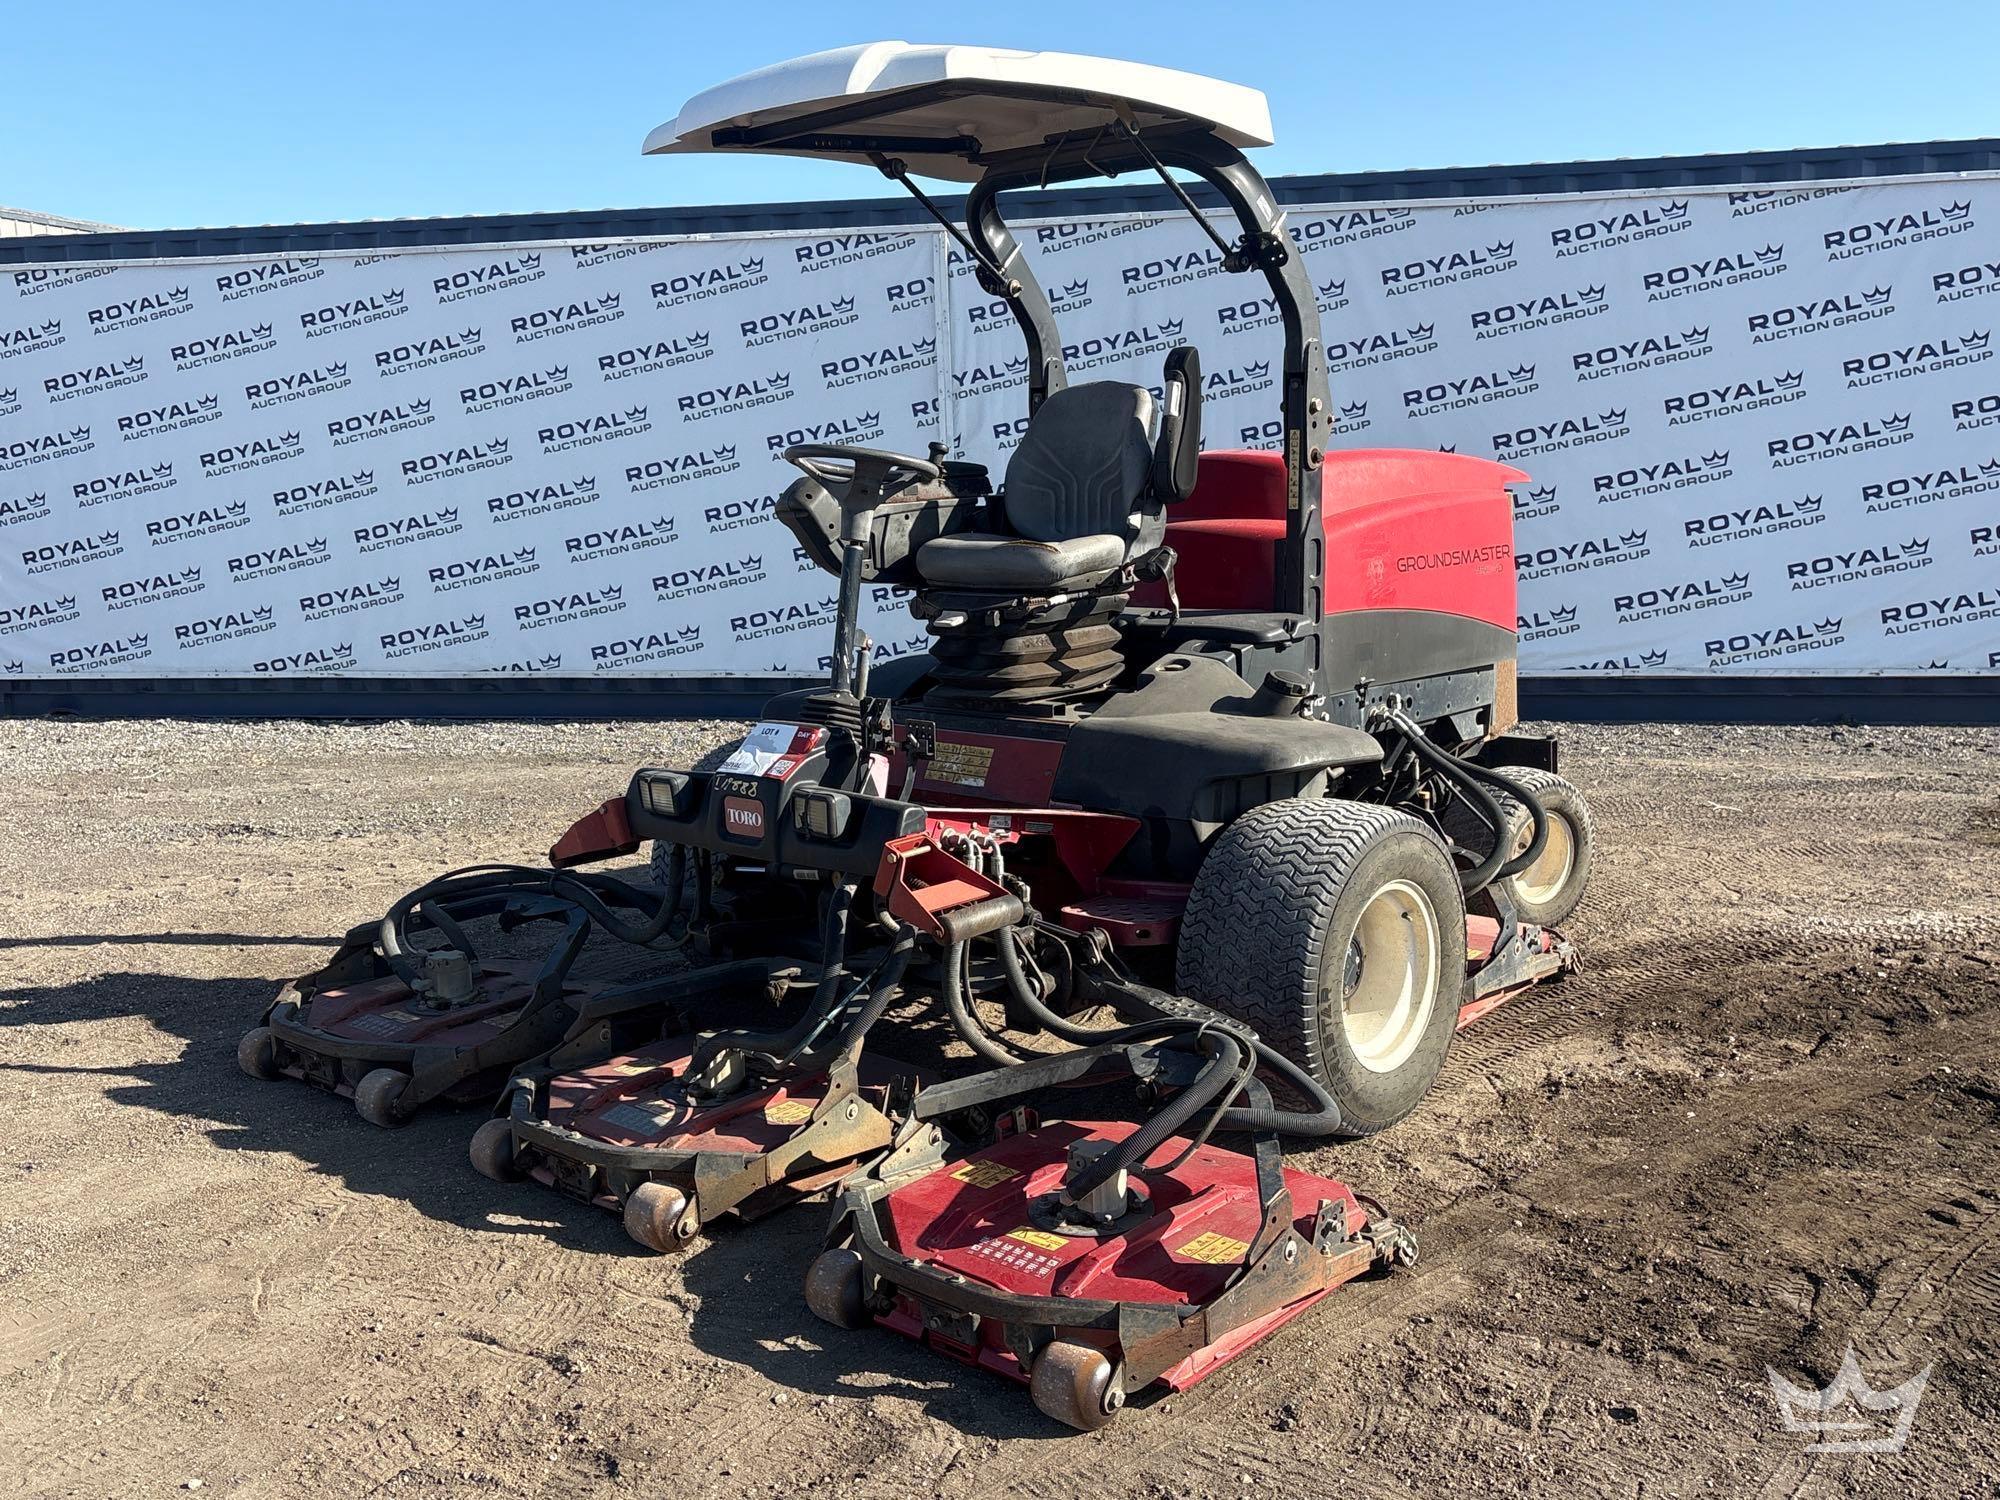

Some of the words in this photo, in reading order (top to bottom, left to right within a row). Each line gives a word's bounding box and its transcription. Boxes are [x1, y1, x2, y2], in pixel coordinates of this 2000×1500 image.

[1551, 209, 1661, 247] ROYAL
[1555, 234, 1630, 259] AUCTION
[1632, 220, 1692, 241] GROUP
[1824, 210, 1941, 250] ROYAL
[1828, 236, 1907, 262] AUCTION
[1910, 221, 1974, 243] GROUP
[433, 261, 520, 294] ROYAL
[650, 265, 742, 299] ROYAL
[1381, 249, 1487, 286] ROYAL
[1386, 273, 1457, 298] AUCTION
[1460, 260, 1518, 280] GROUP
[1643, 253, 1755, 291] ROYAL
[1648, 278, 1723, 303] AUCTION
[1726, 264, 1787, 285] GROUP
[439, 282, 497, 305] AUCTION
[499, 270, 546, 289] GROUP
[656, 287, 717, 310] AUCTION
[719, 275, 768, 294] GROUP
[88, 294, 170, 325] ROYAL
[94, 315, 148, 336] AUCTION
[150, 303, 194, 321] GROUP
[300, 296, 384, 328] ROYAL
[306, 318, 362, 339] AUCTION
[363, 305, 409, 324] GROUP
[510, 301, 599, 333] ROYAL
[740, 304, 832, 337] ROYAL
[1471, 293, 1579, 329] ROYAL
[1475, 317, 1548, 341] AUCTION
[1551, 304, 1609, 324] GROUP
[1748, 295, 1862, 333] ROYAL
[1752, 320, 1830, 345] AUCTION
[1833, 305, 1895, 327] GROUP
[516, 322, 575, 344] AUCTION
[577, 310, 625, 329] GROUP
[745, 326, 807, 348] AUCTION
[809, 314, 859, 333] GROUP
[375, 335, 461, 367] ROYAL
[598, 339, 688, 371] ROYAL
[1061, 327, 1159, 362] ROYAL
[1066, 350, 1132, 373] AUCTION
[1134, 337, 1187, 357] GROUP
[1572, 335, 1682, 370] ROYAL
[1843, 339, 1960, 377] ROYAL
[43, 363, 125, 393] ROYAL
[380, 356, 438, 378] AUCTION
[439, 345, 486, 363] GROUP
[604, 361, 664, 382] AUCTION
[665, 349, 714, 367] GROUP
[1577, 358, 1651, 383] AUCTION
[1654, 345, 1713, 366] GROUP
[1847, 364, 1926, 389] AUCTION
[1929, 350, 1994, 371] GROUP
[50, 383, 103, 404] AUCTION
[105, 372, 148, 390] GROUP
[245, 369, 328, 400] ROYAL
[251, 390, 306, 411] AUCTION
[307, 378, 351, 396] GROUP
[460, 373, 547, 404] ROYAL
[465, 394, 524, 415] AUCTION
[525, 382, 573, 400] GROUP
[677, 380, 768, 412] ROYAL
[1403, 372, 1509, 407] ROYAL
[1408, 396, 1479, 419] AUCTION
[1482, 383, 1539, 403] GROUP
[1664, 379, 1775, 415] ROYAL
[327, 406, 410, 437] ROYAL
[683, 401, 744, 423] AUCTION
[745, 390, 794, 408] GROUP
[1668, 403, 1743, 427] AUCTION
[1746, 390, 1807, 410] GROUP
[333, 427, 388, 447] AUCTION
[390, 415, 435, 433] GROUP
[538, 413, 626, 444] ROYAL
[543, 434, 603, 455] AUCTION
[604, 423, 652, 440] GROUP
[1492, 416, 1600, 451] ROYAL
[1496, 440, 1570, 463] AUCTION
[1572, 427, 1630, 447] GROUP
[1768, 421, 1881, 457] ROYAL
[199, 438, 281, 468] ROYAL
[205, 458, 260, 479] AUCTION
[261, 448, 305, 464] GROUP
[625, 451, 715, 482] ROYAL
[1772, 446, 1848, 469] AUCTION
[1852, 432, 1914, 453] GROUP
[73, 469, 154, 498] ROYAL
[631, 473, 691, 493] AUCTION
[692, 462, 740, 479] GROUP
[1593, 458, 1702, 492] ROYAL
[1598, 481, 1671, 504] AUCTION
[1674, 469, 1733, 488] GROUP
[79, 489, 132, 508] AUCTION
[134, 478, 177, 495] GROUP
[273, 477, 354, 507] ROYAL
[278, 497, 333, 517] AUCTION
[334, 486, 378, 503] GROUP
[146, 508, 228, 536] ROYAL
[152, 527, 206, 547] AUCTION
[207, 517, 251, 533] GROUP
[354, 514, 438, 543] ROYAL
[1684, 503, 1794, 537] ROYAL
[1688, 526, 1763, 549] AUCTION
[1766, 514, 1826, 533] GROUP
[22, 537, 101, 565] ROYAL
[359, 534, 415, 554] AUCTION
[416, 524, 463, 540] GROUP
[565, 523, 653, 553] ROYAL
[571, 544, 629, 564] AUCTION
[631, 533, 679, 550] GROUP
[1514, 538, 1620, 571] ROYAL
[27, 557, 80, 575] AUCTION
[81, 546, 124, 563] GROUP
[428, 553, 515, 583] ROYAL
[1396, 544, 1511, 573] GROUNDSMASTER
[1517, 560, 1590, 583] AUCTION
[1593, 548, 1650, 567] GROUP
[1787, 546, 1900, 579] ROYAL
[1791, 569, 1868, 591] AUCTION
[1871, 557, 1933, 576] GROUP
[101, 573, 182, 602] ROYAL
[434, 574, 492, 593] AUCTION
[494, 563, 540, 580] GROUP
[652, 562, 741, 592] ROYAL
[657, 582, 717, 602] AUCTION
[719, 572, 767, 589] GROUP
[108, 593, 161, 612] AUCTION
[162, 583, 205, 599] GROUP
[1614, 580, 1722, 612] ROYAL
[1618, 602, 1691, 624] AUCTION
[1694, 591, 1753, 609] GROUP
[174, 613, 254, 640] ROYAL
[179, 631, 232, 650] AUCTION
[234, 622, 277, 638] GROUP
[380, 621, 464, 649] ROYAL
[1704, 625, 1814, 657] ROYAL
[385, 641, 442, 659] AUCTION
[443, 631, 489, 647] GROUP
[591, 632, 679, 661] ROYAL
[596, 652, 655, 671] AUCTION
[657, 642, 704, 658] GROUP
[1709, 647, 1782, 669] AUCTION
[1785, 636, 1845, 654] GROUP
[761, 728, 775, 736] LOT
[797, 731, 811, 739] DAY
[727, 808, 762, 827] TORO
[1320, 987, 1353, 1098] CARLSTAR
